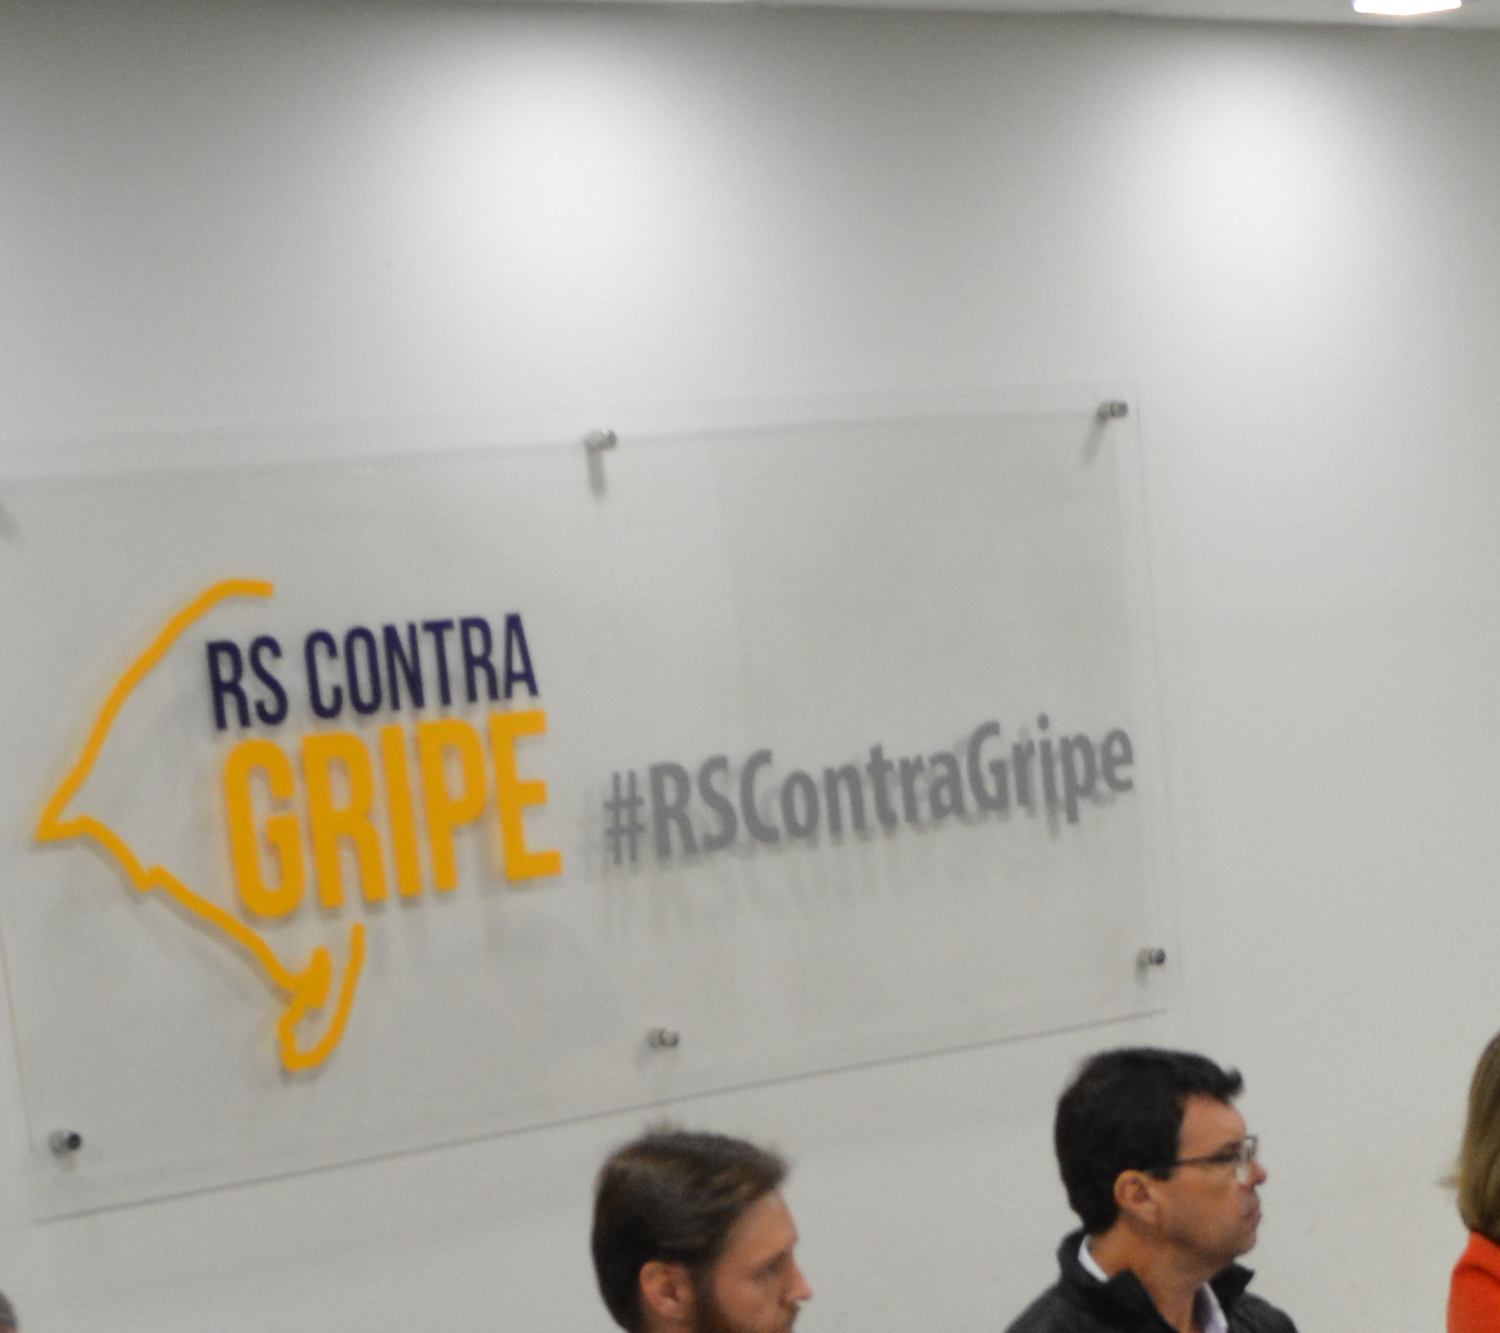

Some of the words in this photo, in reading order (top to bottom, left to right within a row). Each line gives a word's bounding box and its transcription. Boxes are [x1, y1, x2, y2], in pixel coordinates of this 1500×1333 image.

[206, 635, 289, 731] RS
[303, 612, 540, 720] CONTRA
[222, 708, 563, 919] GRIPE
[604, 712, 1135, 866] #RSContraGripe
